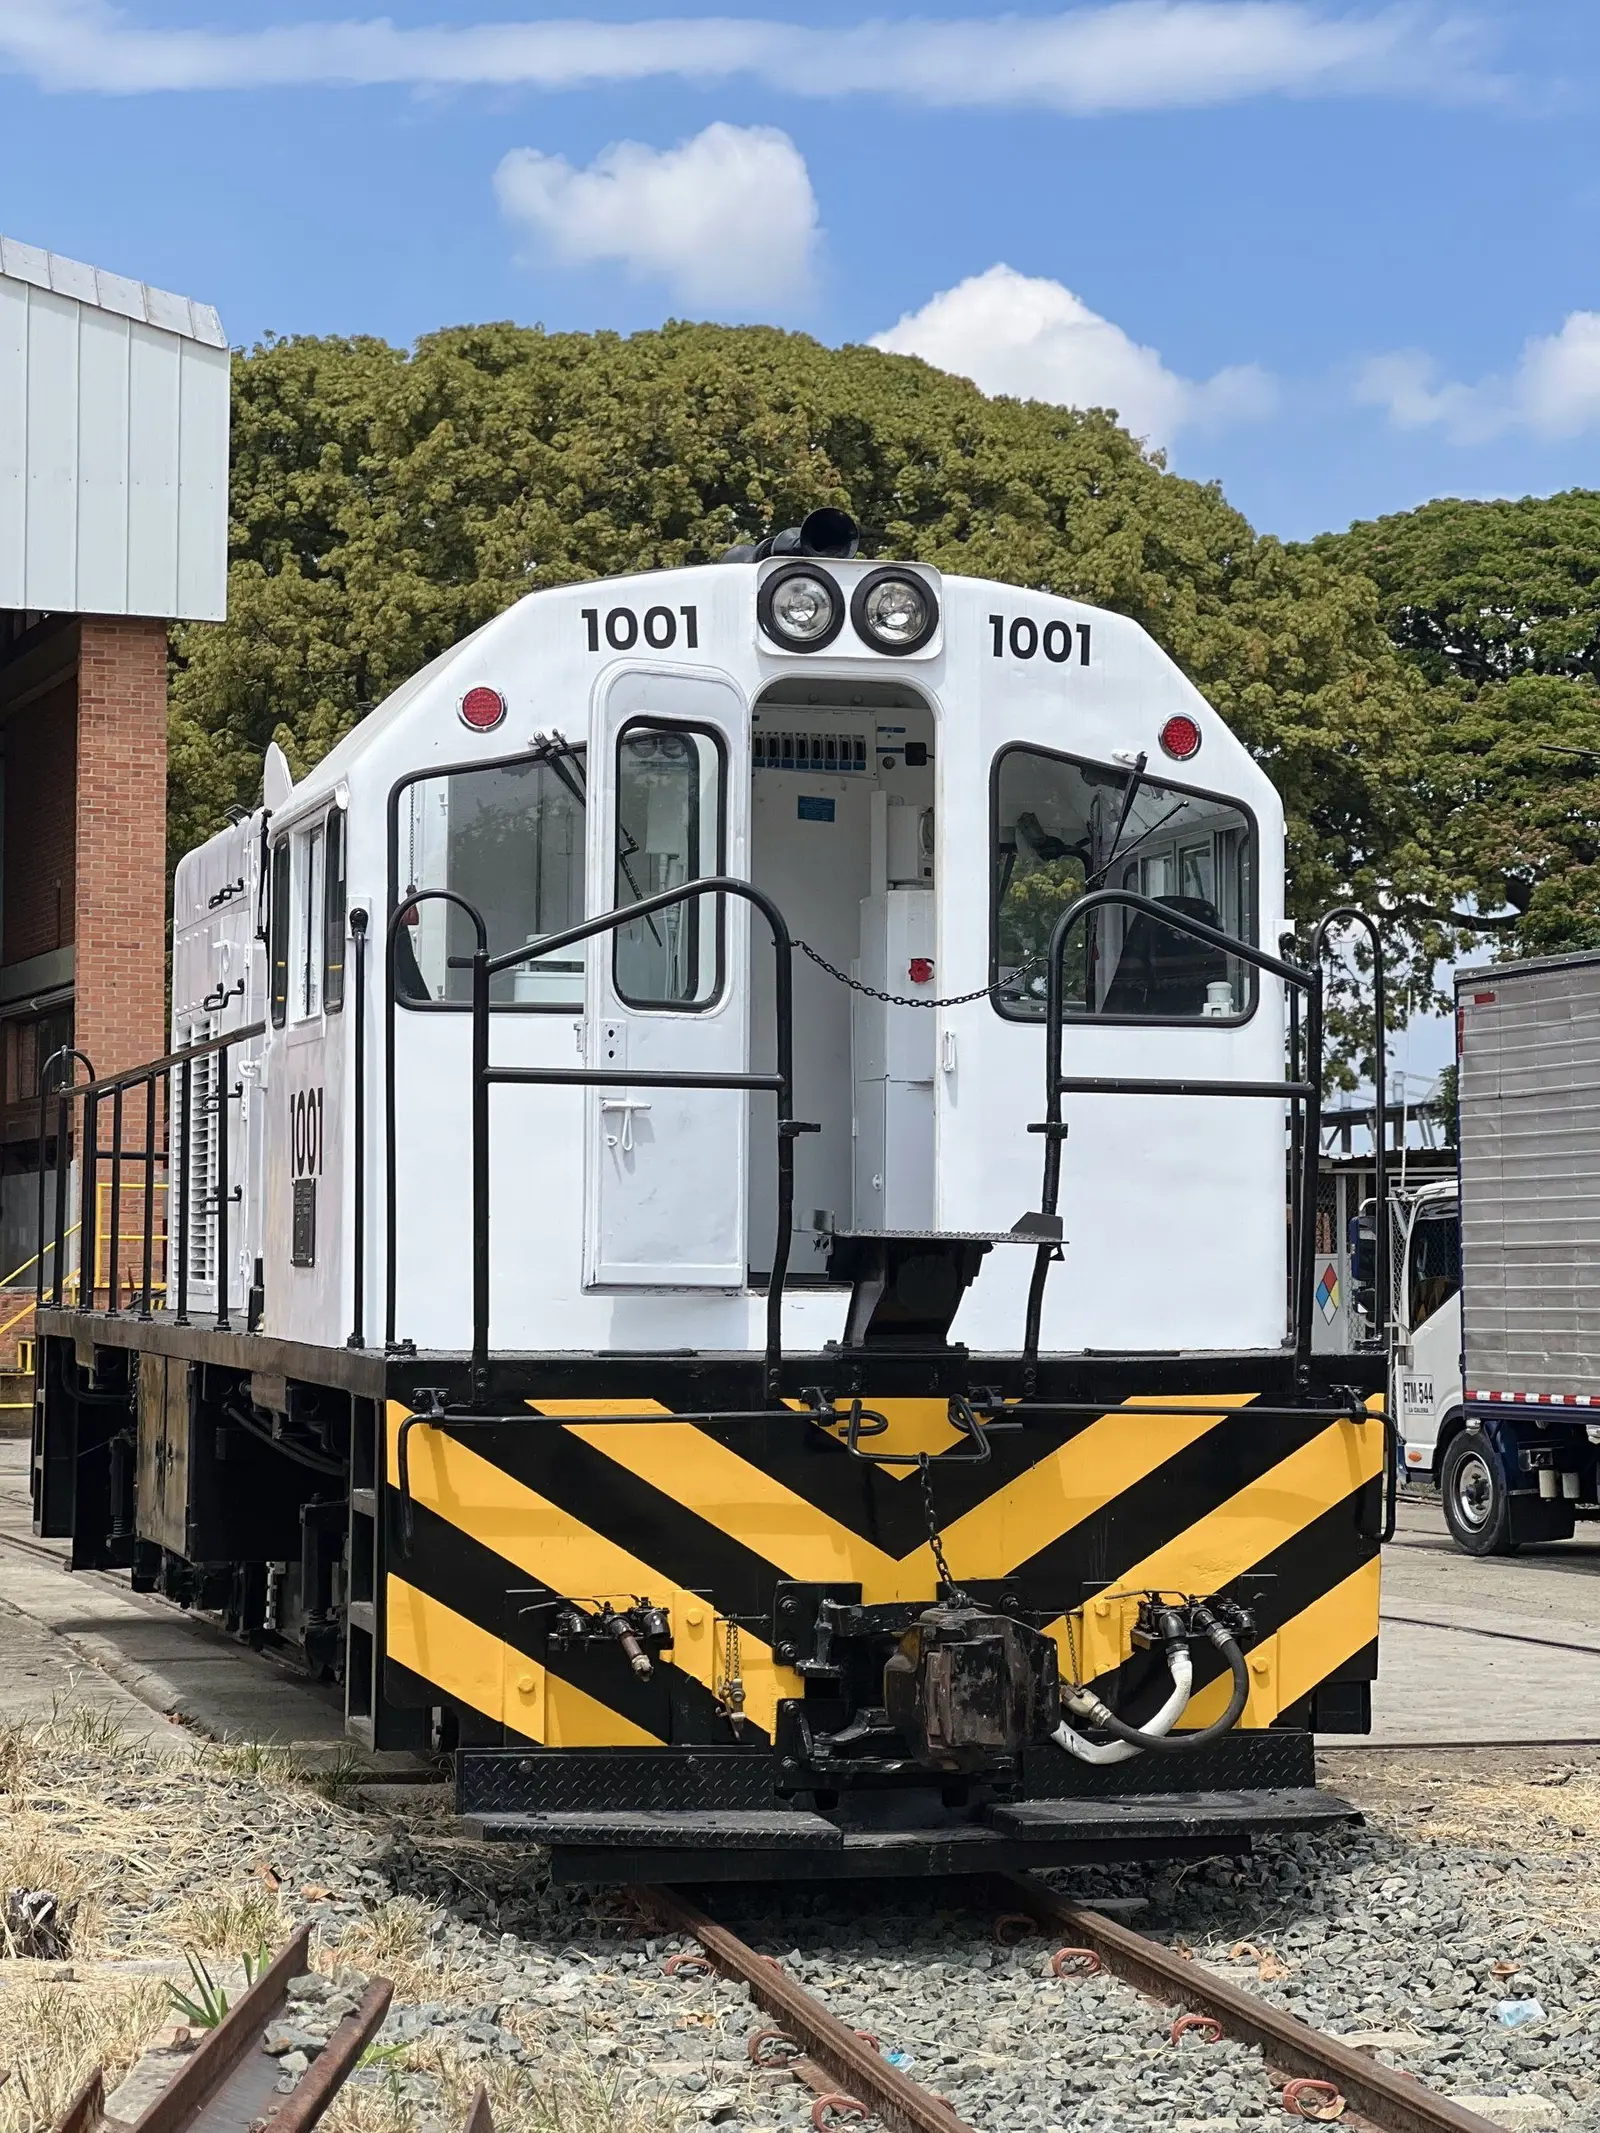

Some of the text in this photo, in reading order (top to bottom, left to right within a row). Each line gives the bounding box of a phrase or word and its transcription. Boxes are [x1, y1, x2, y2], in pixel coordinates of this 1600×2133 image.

[581, 605, 699, 652] 1001
[988, 613, 1092, 666] 1001
[290, 1087, 323, 1178] 1001
